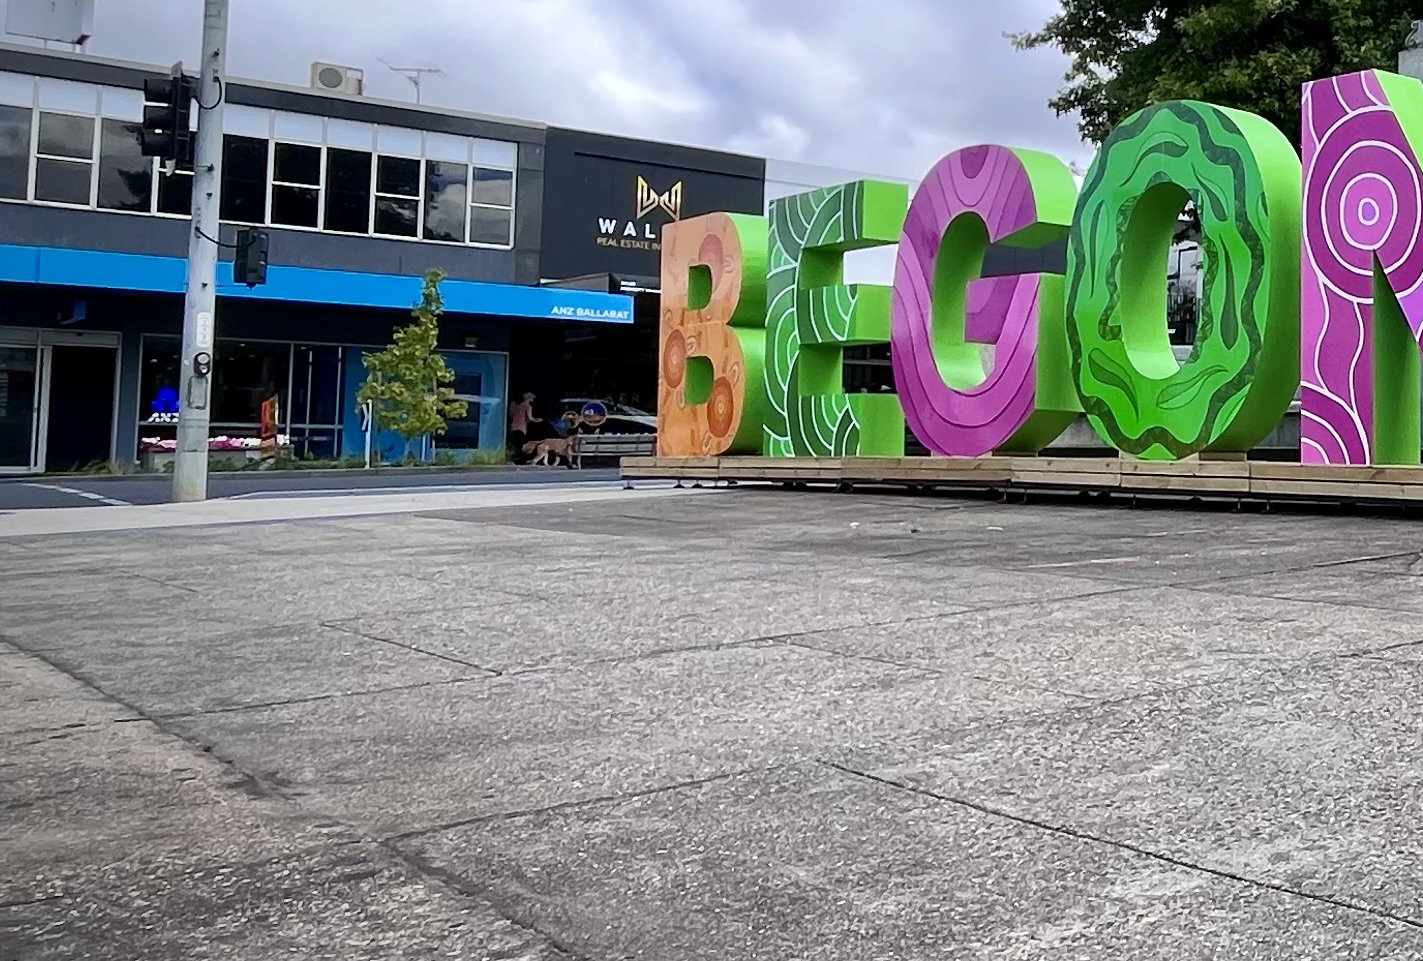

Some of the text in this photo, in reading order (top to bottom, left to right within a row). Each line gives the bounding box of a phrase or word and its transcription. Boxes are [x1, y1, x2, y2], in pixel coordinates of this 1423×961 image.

[597, 237, 618, 247] REAL
[620, 239, 650, 250] ESTATE
[551, 306, 629, 320] ANZ BALLARAT
